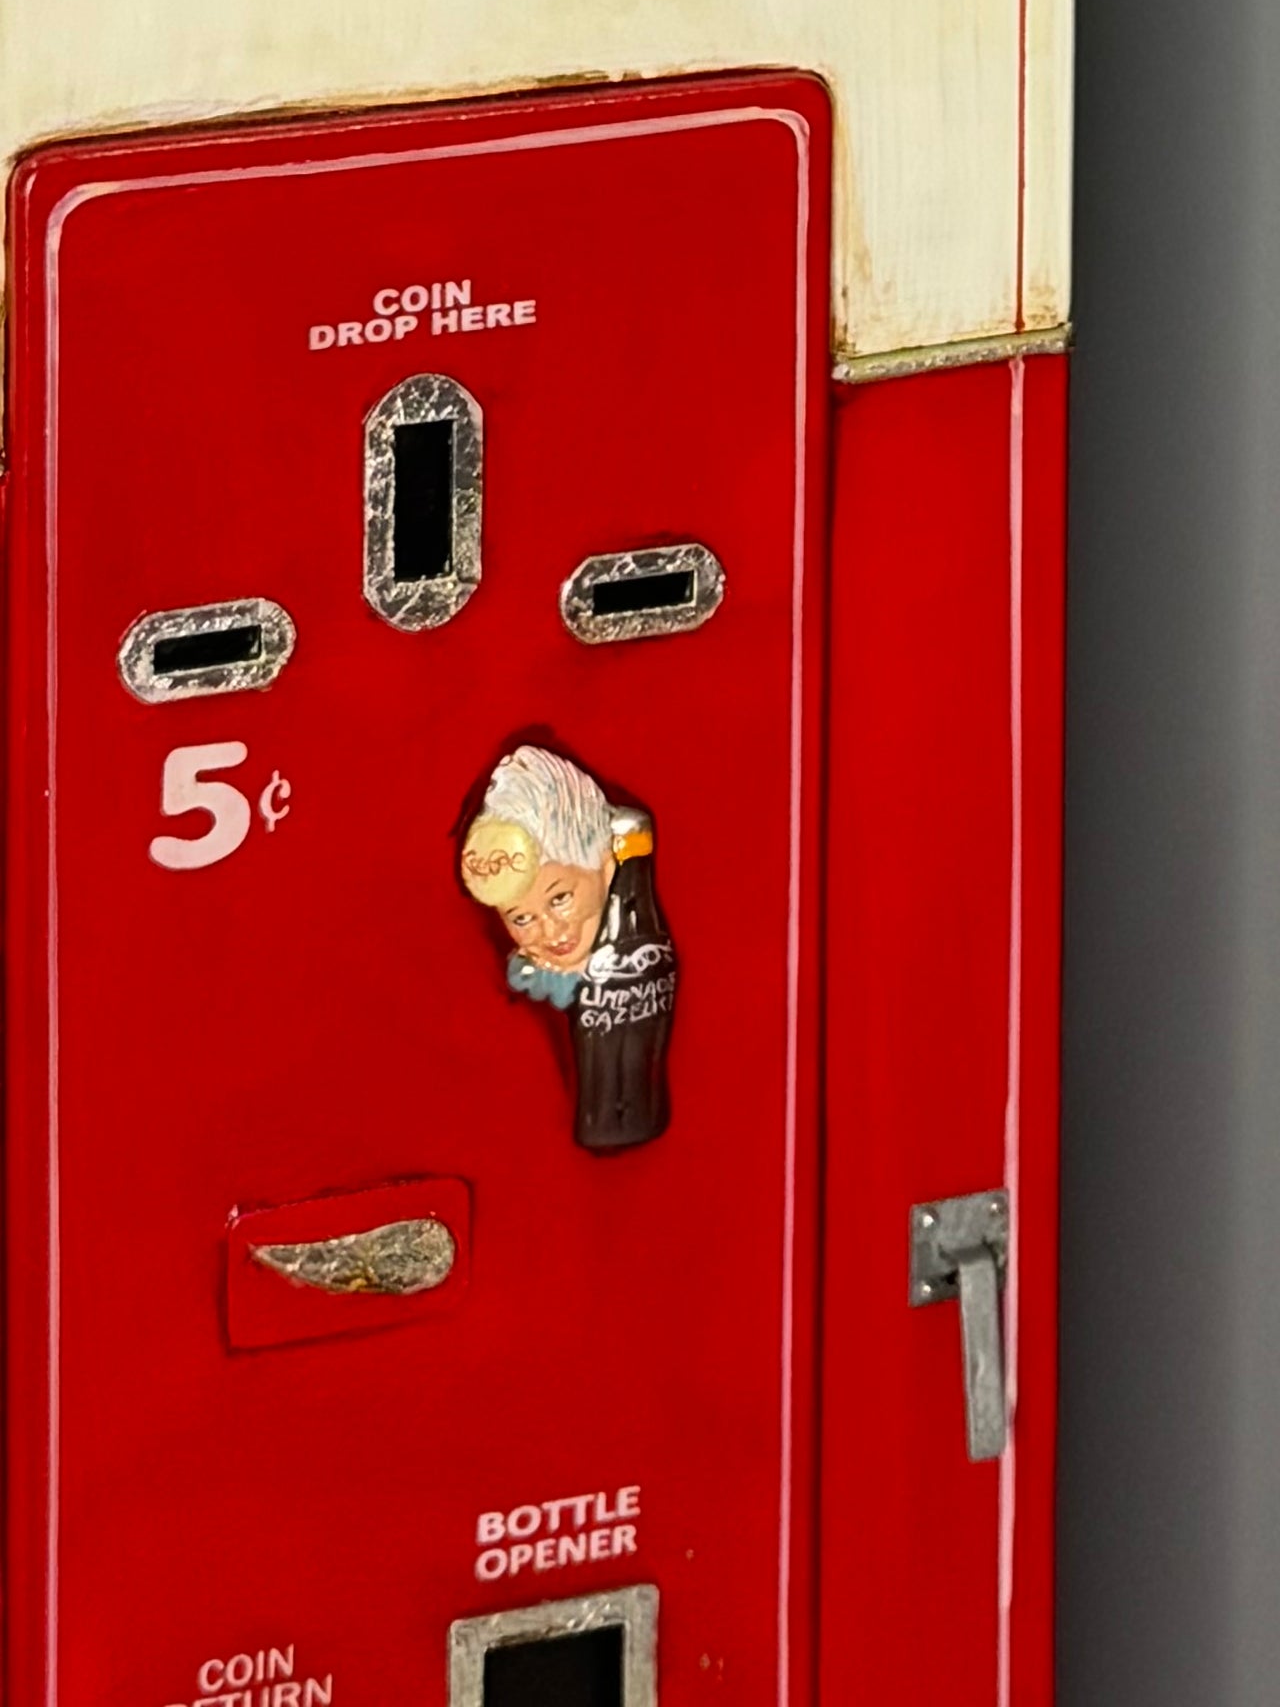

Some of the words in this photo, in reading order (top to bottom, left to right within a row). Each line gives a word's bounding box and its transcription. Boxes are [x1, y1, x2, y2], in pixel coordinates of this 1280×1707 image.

[373, 279, 472, 316] COIN
[308, 315, 419, 351] DROP
[431, 299, 537, 336] HERE
[476, 1485, 641, 1546] BOTTLE
[474, 1524, 638, 1581] OPENER
[163, 1673, 333, 1707] TURN
[197, 1643, 295, 1695] COIN
